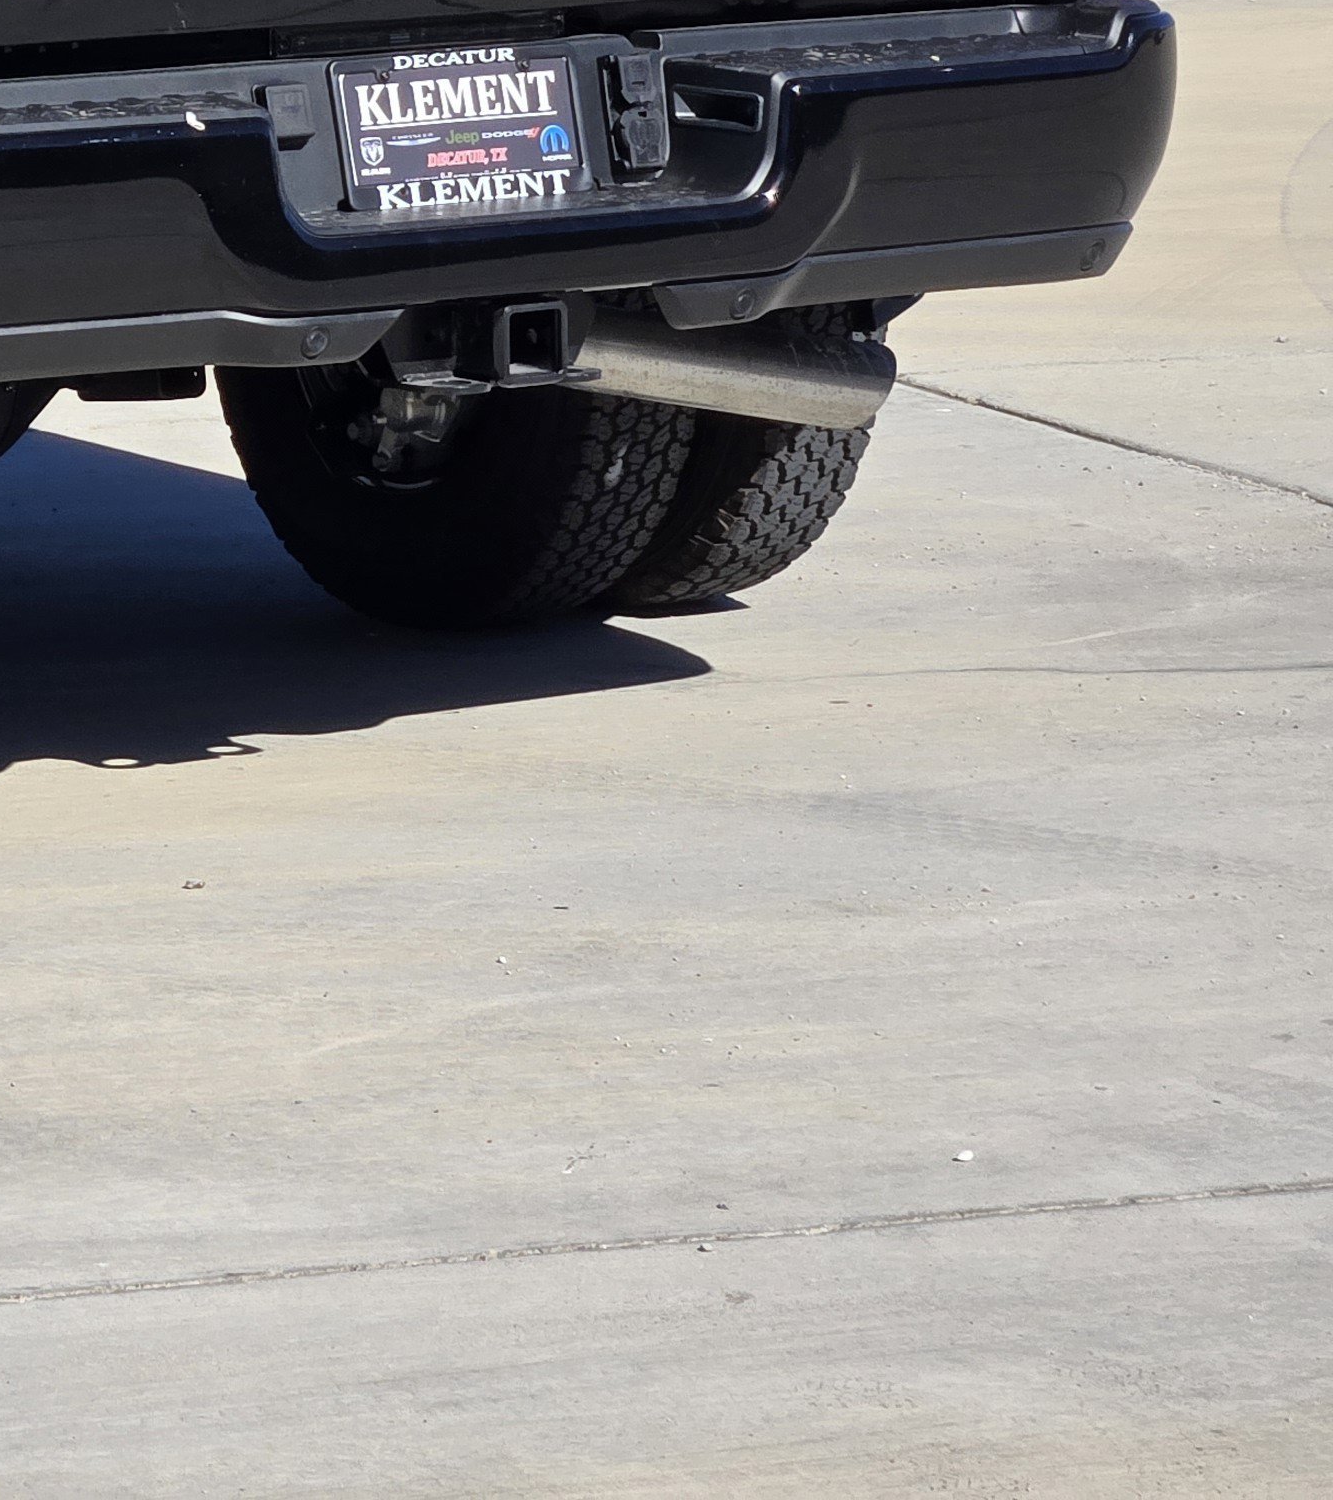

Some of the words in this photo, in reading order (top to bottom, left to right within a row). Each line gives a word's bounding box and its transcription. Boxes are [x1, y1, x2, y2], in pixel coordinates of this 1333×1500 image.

[392, 47, 516, 71] DECATUR
[354, 69, 556, 127] KLEMENT
[445, 129, 480, 145] Jeep
[481, 129, 533, 139] DODGE
[426, 148, 489, 168] DECATUR,
[489, 146, 508, 162] TX
[376, 168, 571, 211] KLEMENT
